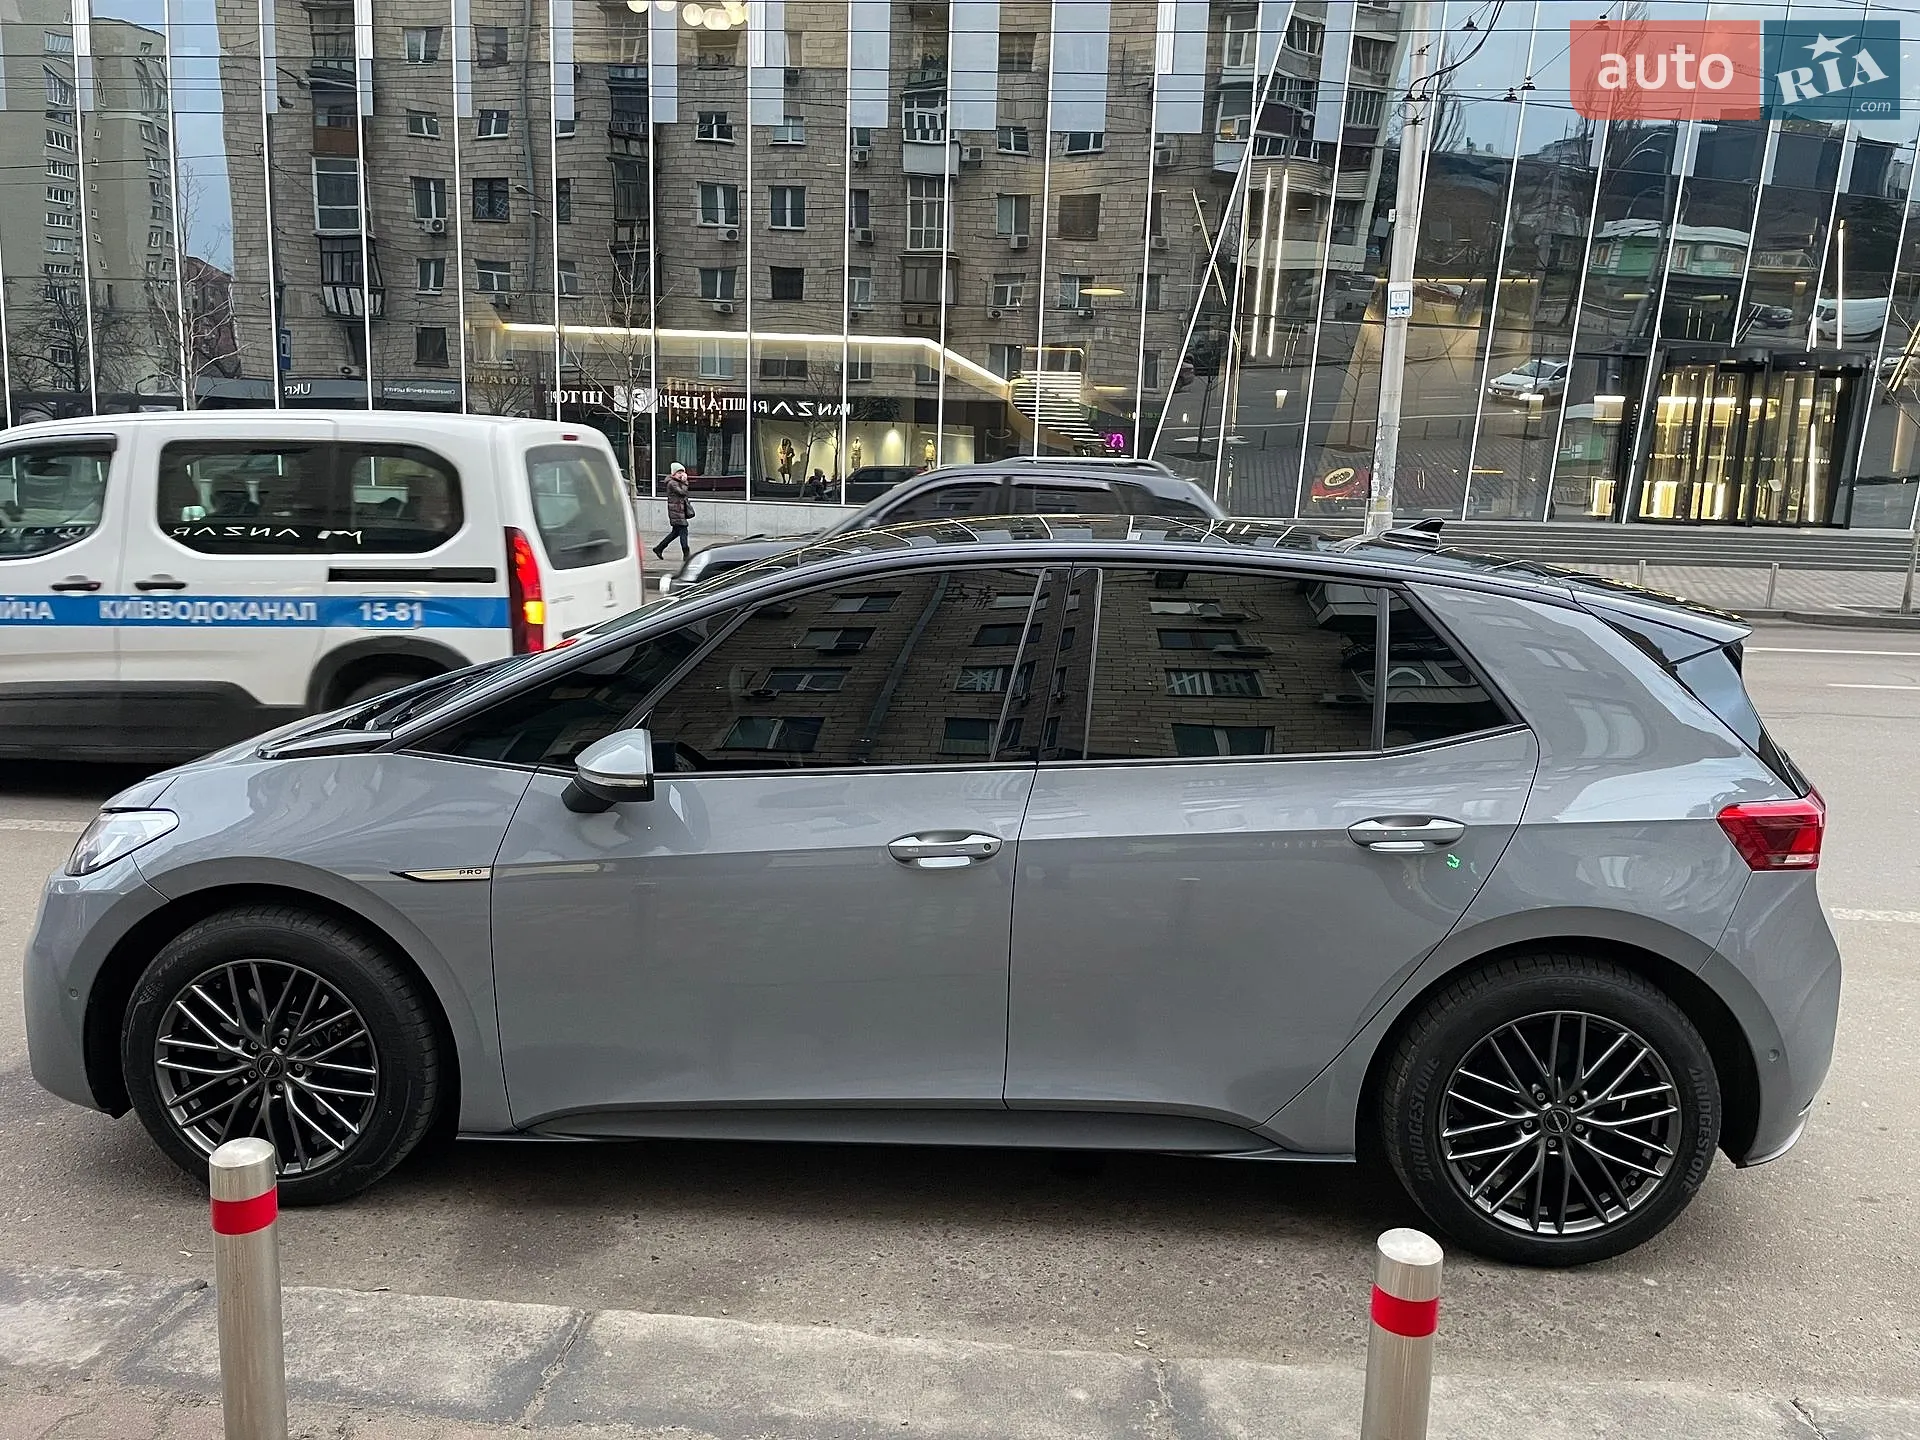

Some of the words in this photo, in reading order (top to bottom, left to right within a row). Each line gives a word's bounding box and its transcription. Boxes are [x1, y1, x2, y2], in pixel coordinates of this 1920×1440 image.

[98, 596, 318, 624] КИЇВВОДОКАНАЛ
[358, 601, 423, 623] 15-81
[459, 868, 482, 876] PRO
